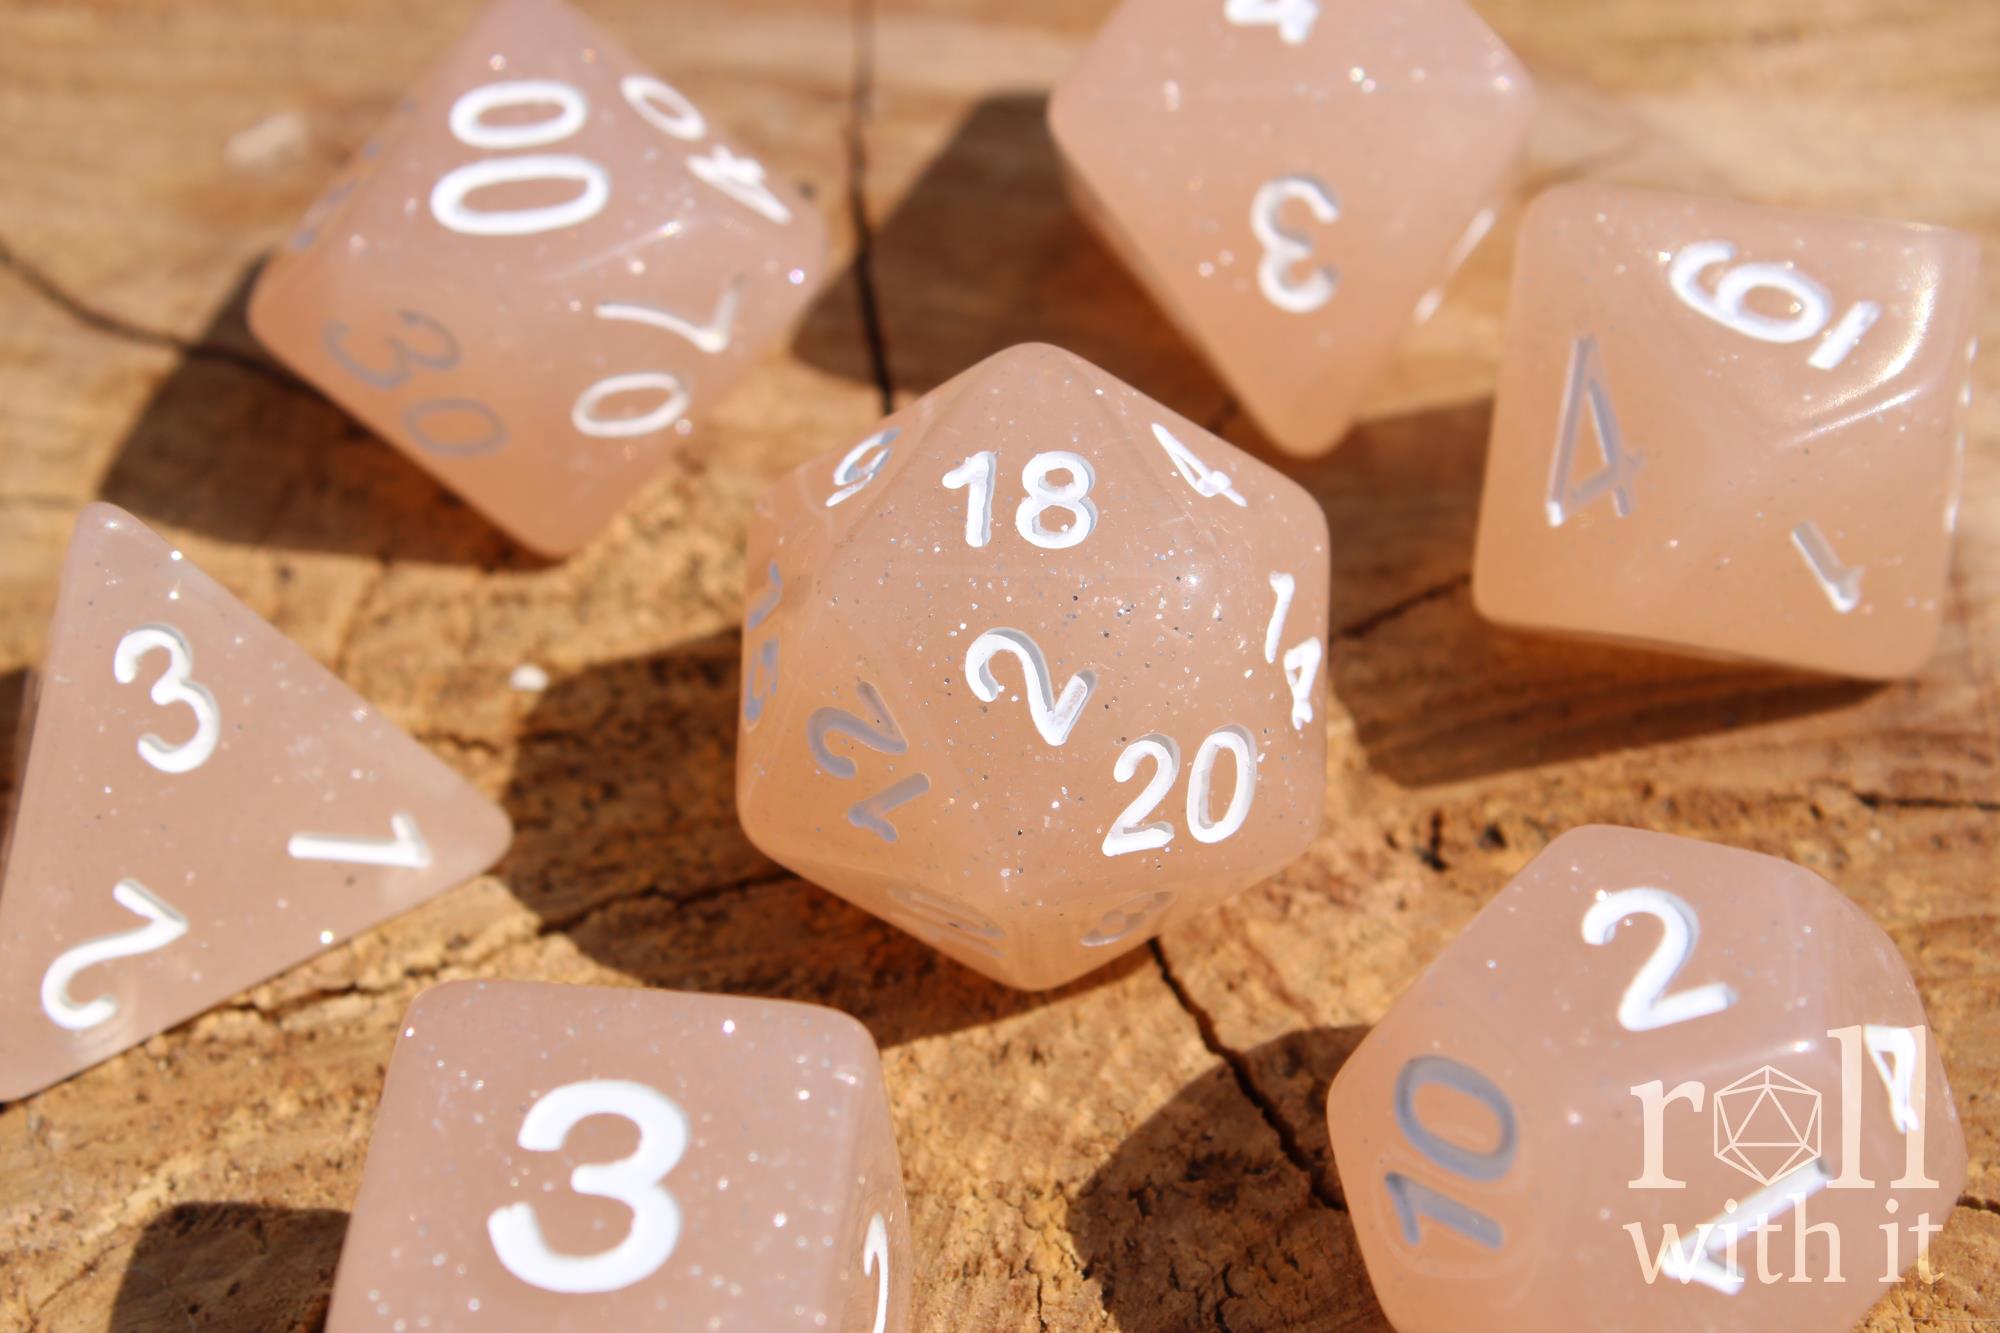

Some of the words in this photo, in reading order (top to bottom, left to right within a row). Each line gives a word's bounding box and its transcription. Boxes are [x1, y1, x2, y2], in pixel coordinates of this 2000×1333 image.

[430, 79, 609, 236] 00
[1250, 174, 1341, 313] 3
[322, 309, 508, 458] 30
[572, 275, 746, 438] 70
[1545, 333, 1644, 528] 4
[942, 451, 1098, 549] 18
[1151, 423, 1248, 507] 4
[114, 624, 220, 774] 3
[964, 627, 1097, 746] 2
[1265, 570, 1321, 730] 14
[808, 681, 931, 842] 12
[1102, 724, 1257, 857] 20
[288, 814, 430, 868] 1
[40, 878, 189, 1033] 2
[1581, 886, 1738, 1032] 2
[488, 1078, 690, 1294] 3
[1384, 1054, 1517, 1250] 10
